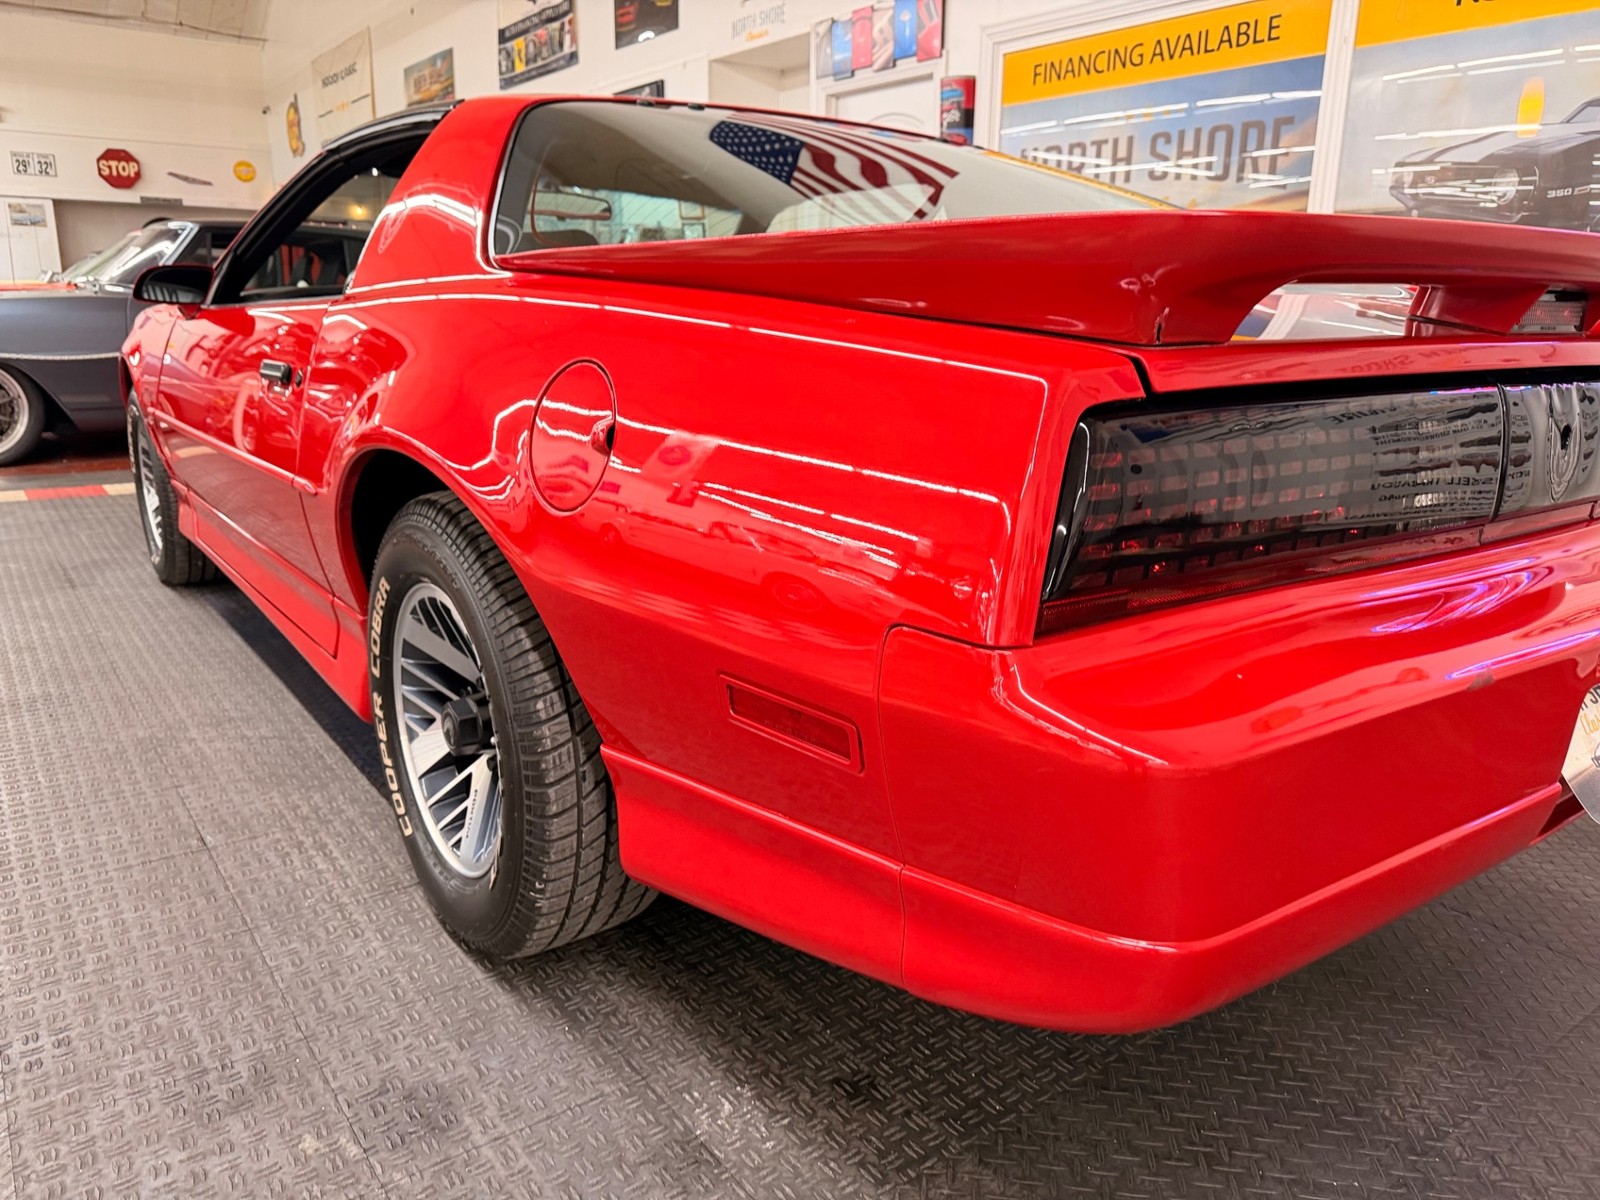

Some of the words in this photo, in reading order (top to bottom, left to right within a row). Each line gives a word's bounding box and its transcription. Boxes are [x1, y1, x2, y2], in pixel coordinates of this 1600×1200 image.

[1033, 43, 1145, 86] FINANCING
[1149, 14, 1283, 64] AVAILABLE
[98, 159, 139, 177] STOP
[1546, 187, 1572, 198] 350
[369, 575, 391, 679] COBRA
[372, 691, 414, 838] COOPER
